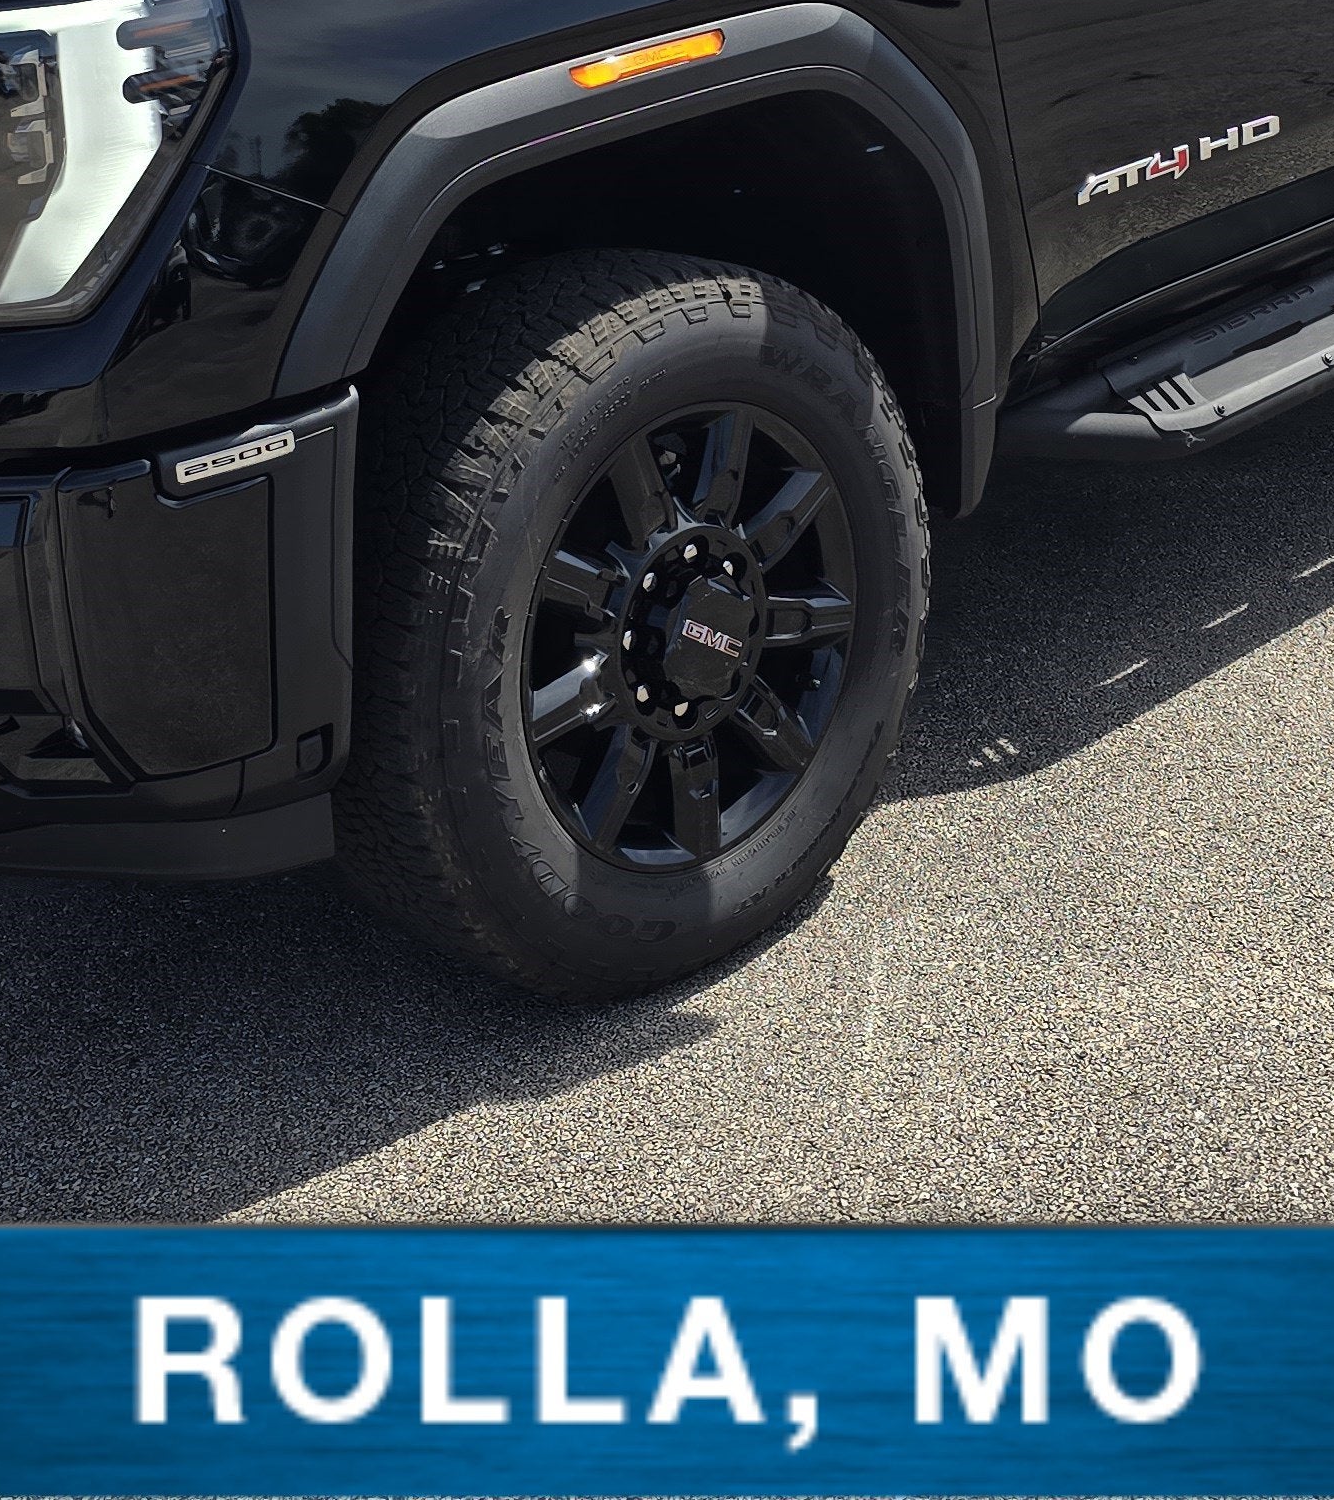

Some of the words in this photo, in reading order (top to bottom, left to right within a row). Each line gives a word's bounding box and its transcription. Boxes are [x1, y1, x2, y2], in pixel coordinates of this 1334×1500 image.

[1077, 144, 1190, 206] AT4
[1199, 115, 1280, 161] HD
[184, 438, 288, 477] 2500
[682, 619, 743, 658] GMC
